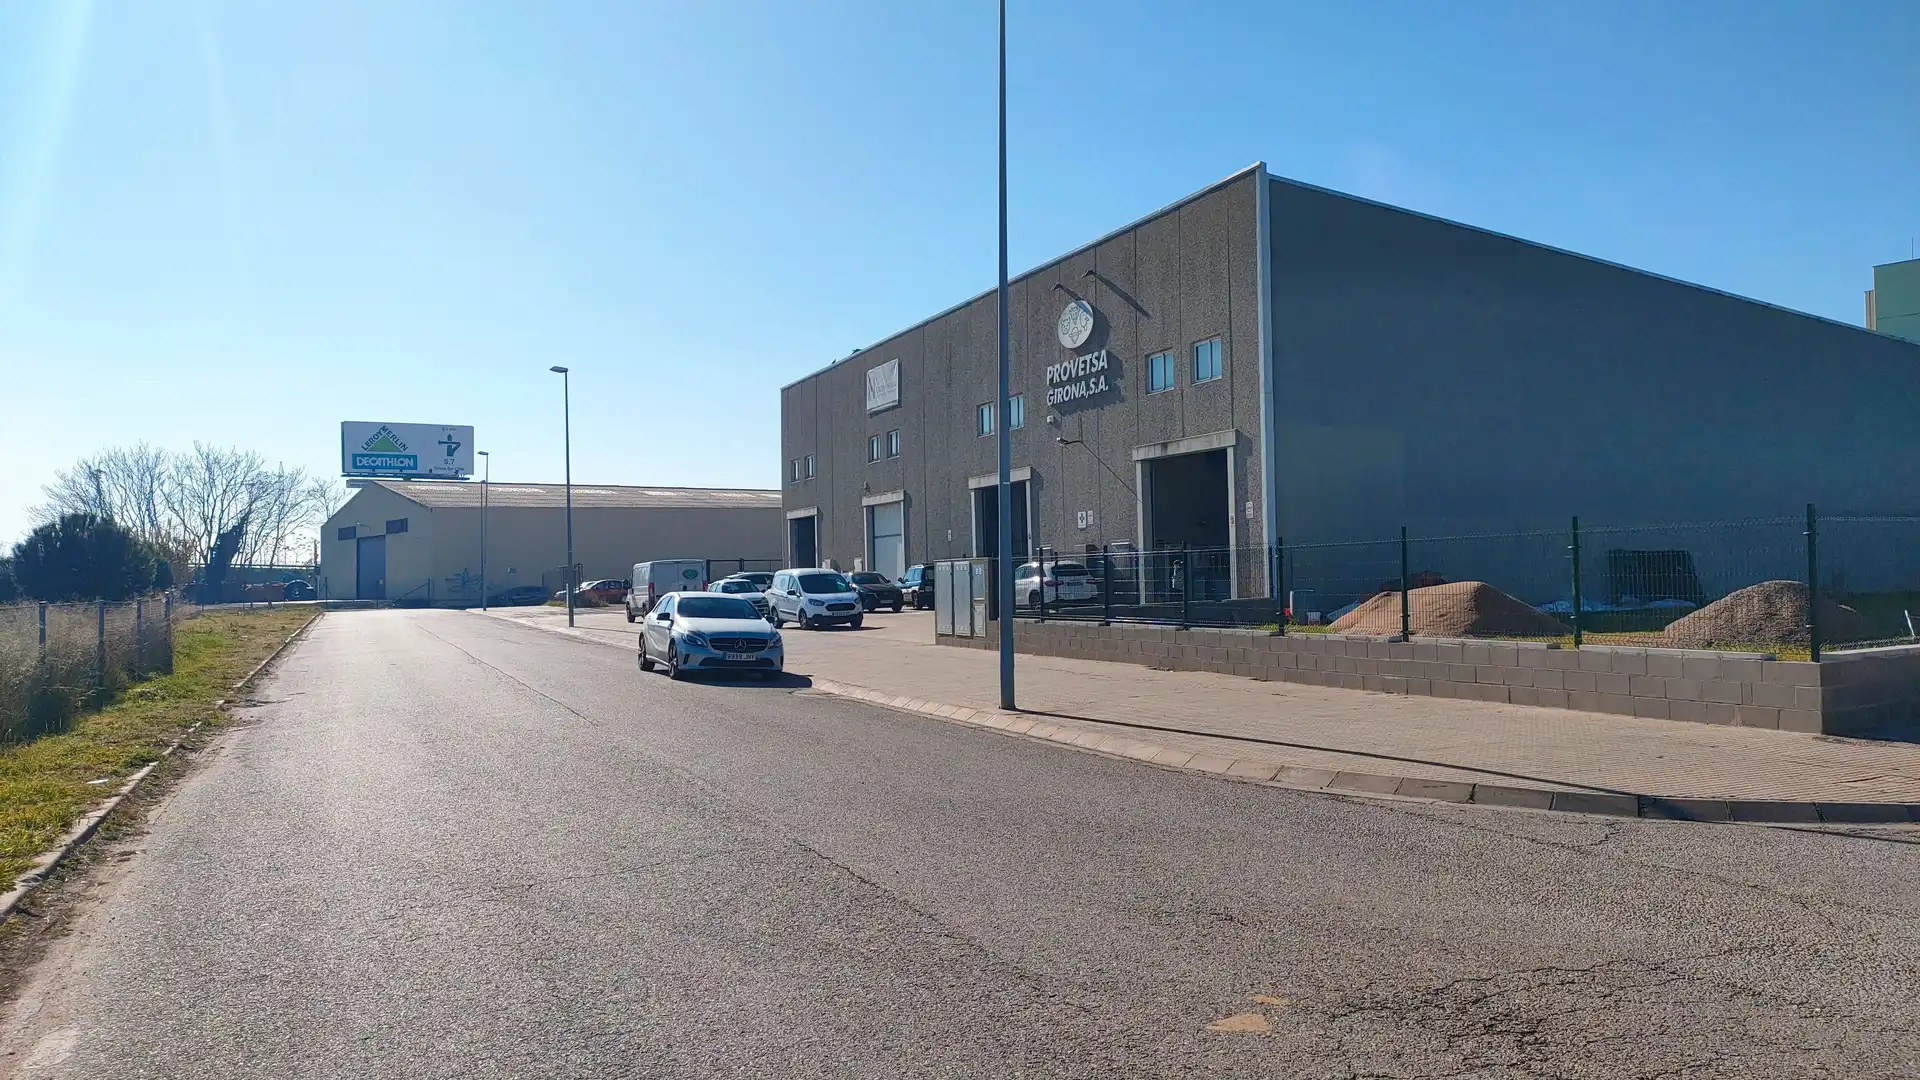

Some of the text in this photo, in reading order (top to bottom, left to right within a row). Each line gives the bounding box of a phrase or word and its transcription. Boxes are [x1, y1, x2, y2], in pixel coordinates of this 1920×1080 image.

[1047, 349, 1108, 386] PROVETSA
[361, 425, 409, 452] LEROY MERLIN
[356, 456, 414, 467] DECATHLON
